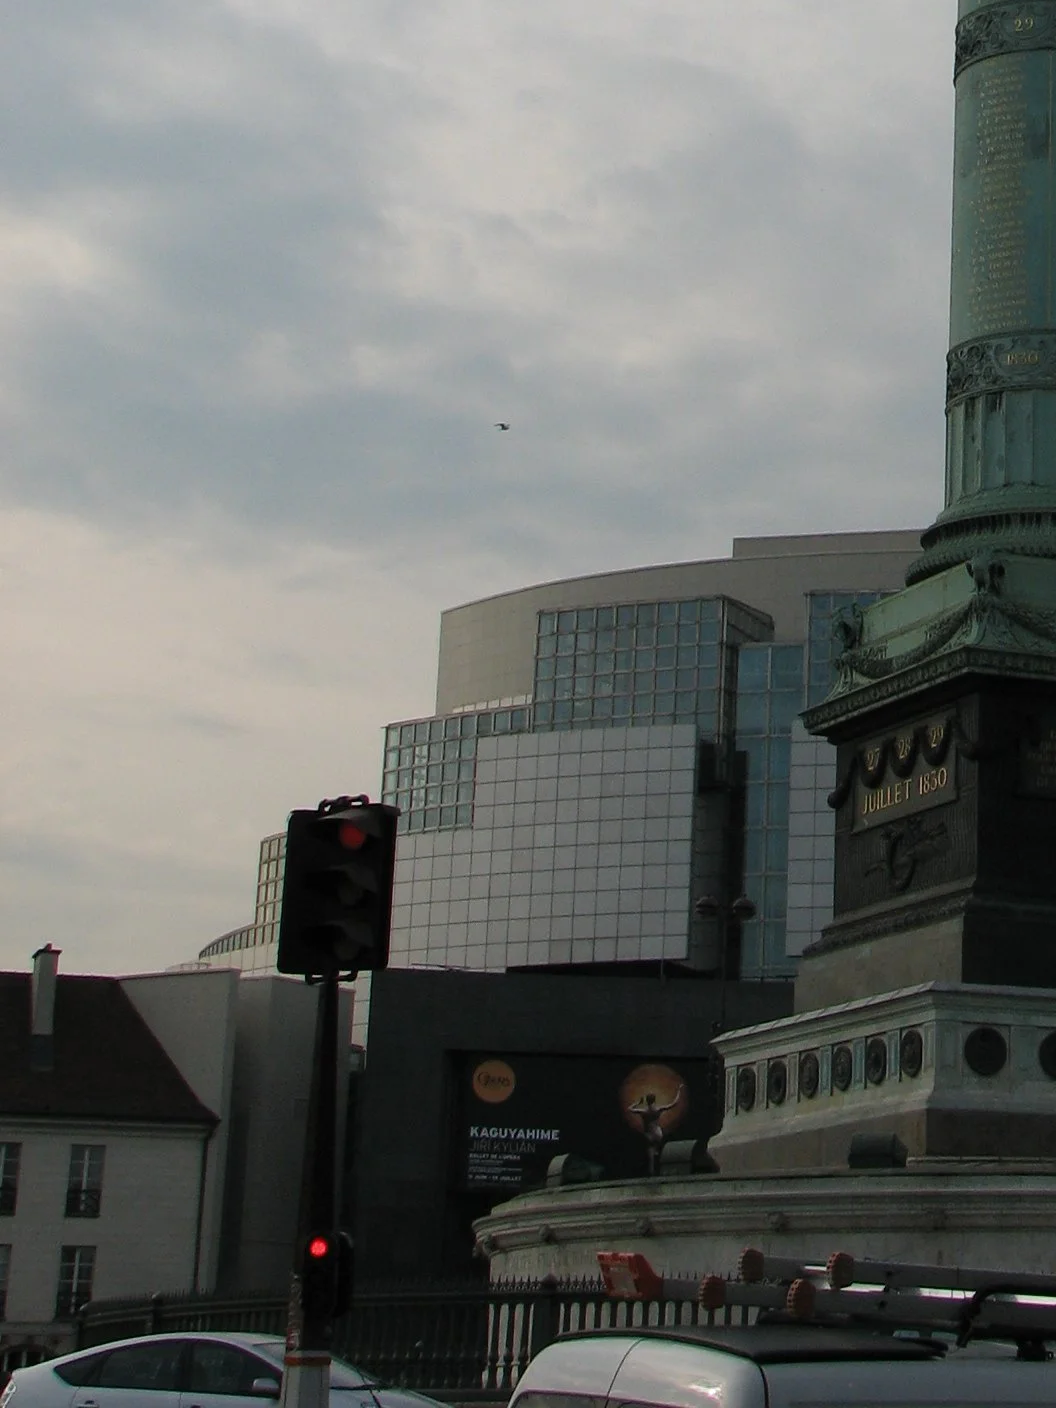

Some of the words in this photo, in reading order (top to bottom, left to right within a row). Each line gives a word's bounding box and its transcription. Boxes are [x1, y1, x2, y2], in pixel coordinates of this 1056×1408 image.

[1014, 16, 1034, 32] 29
[1007, 351, 1038, 366] 1830
[866, 747, 881, 771] 27
[897, 736, 912, 760] 28
[930, 724, 945, 749] 29
[862, 778, 913, 815] JUILLET
[919, 767, 948, 796] 1830
[469, 1126, 560, 1141] KAGUYAHIME
